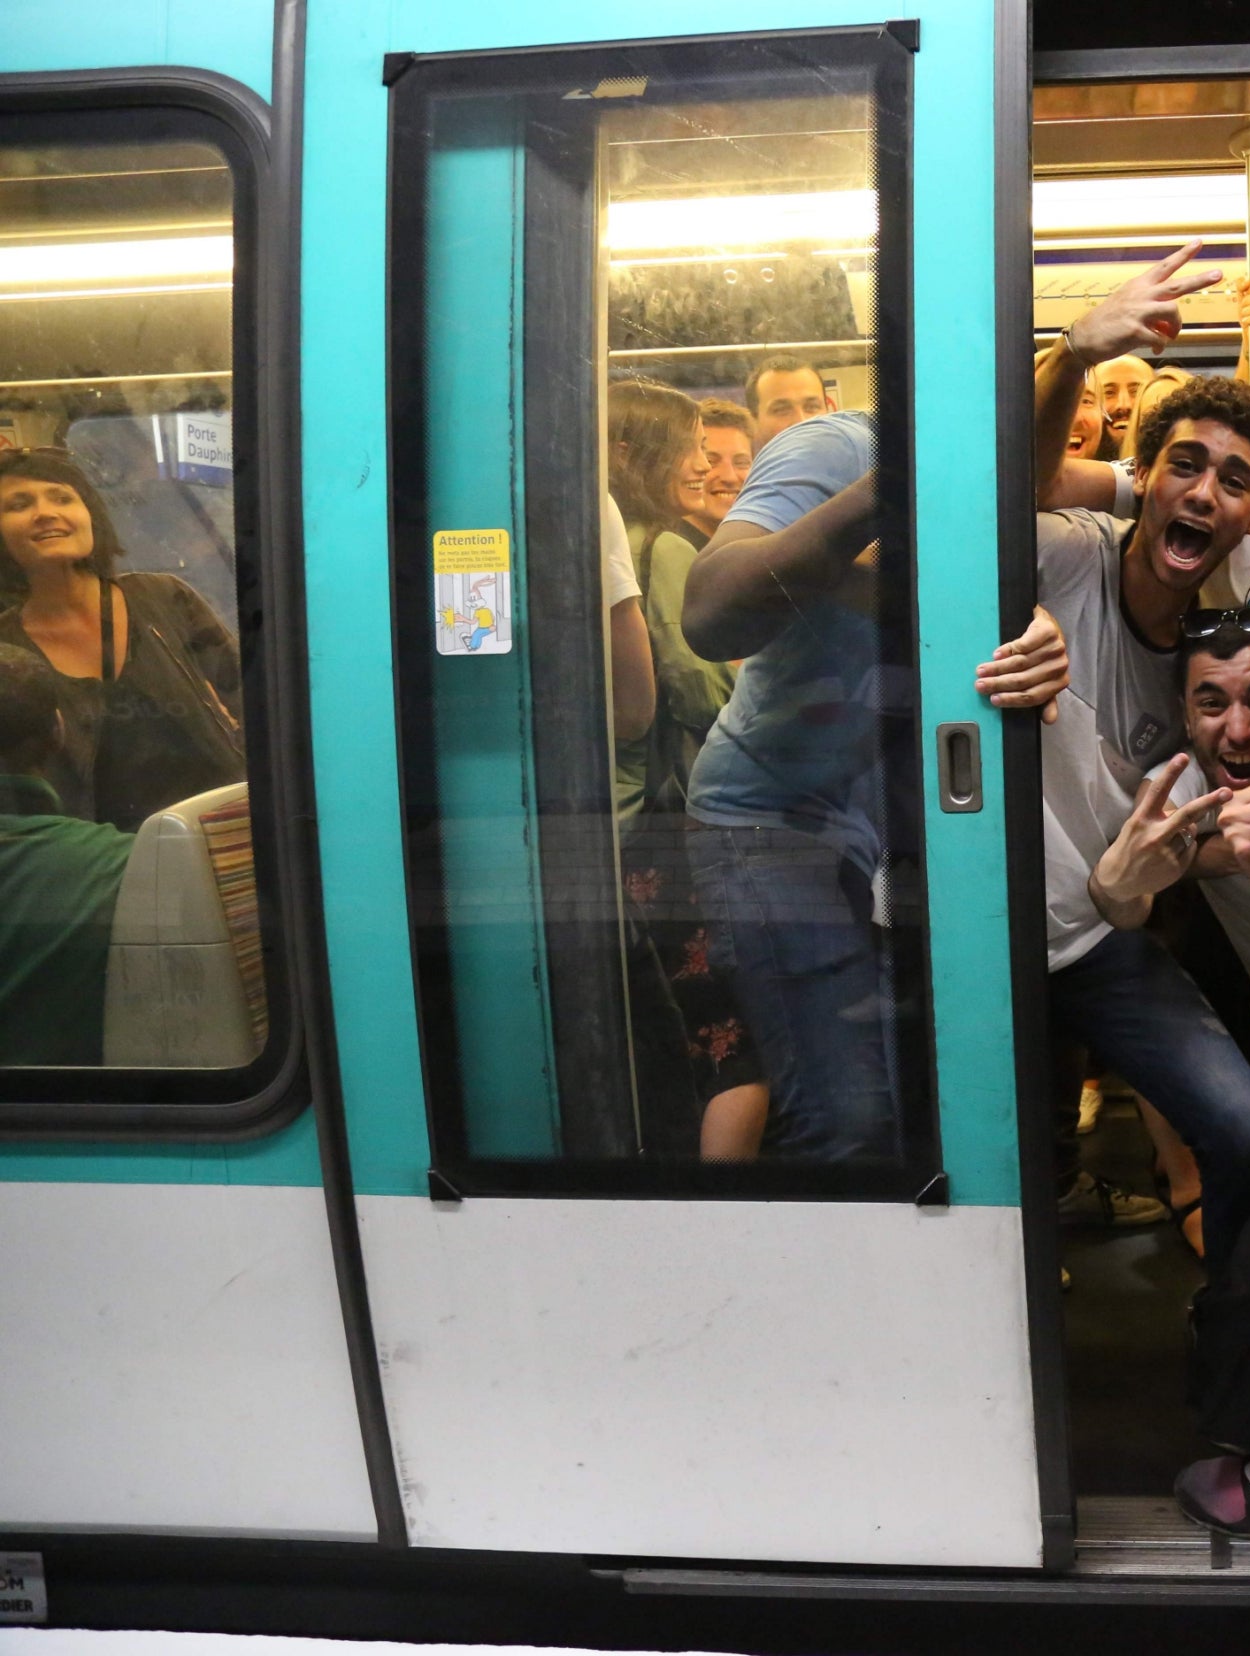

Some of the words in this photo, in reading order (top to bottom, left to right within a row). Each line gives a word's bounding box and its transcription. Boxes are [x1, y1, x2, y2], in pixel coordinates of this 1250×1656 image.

[187, 423, 217, 443] Porte
[439, 534, 495, 546] Attention
[0, 1599, 33, 1612] DIER
